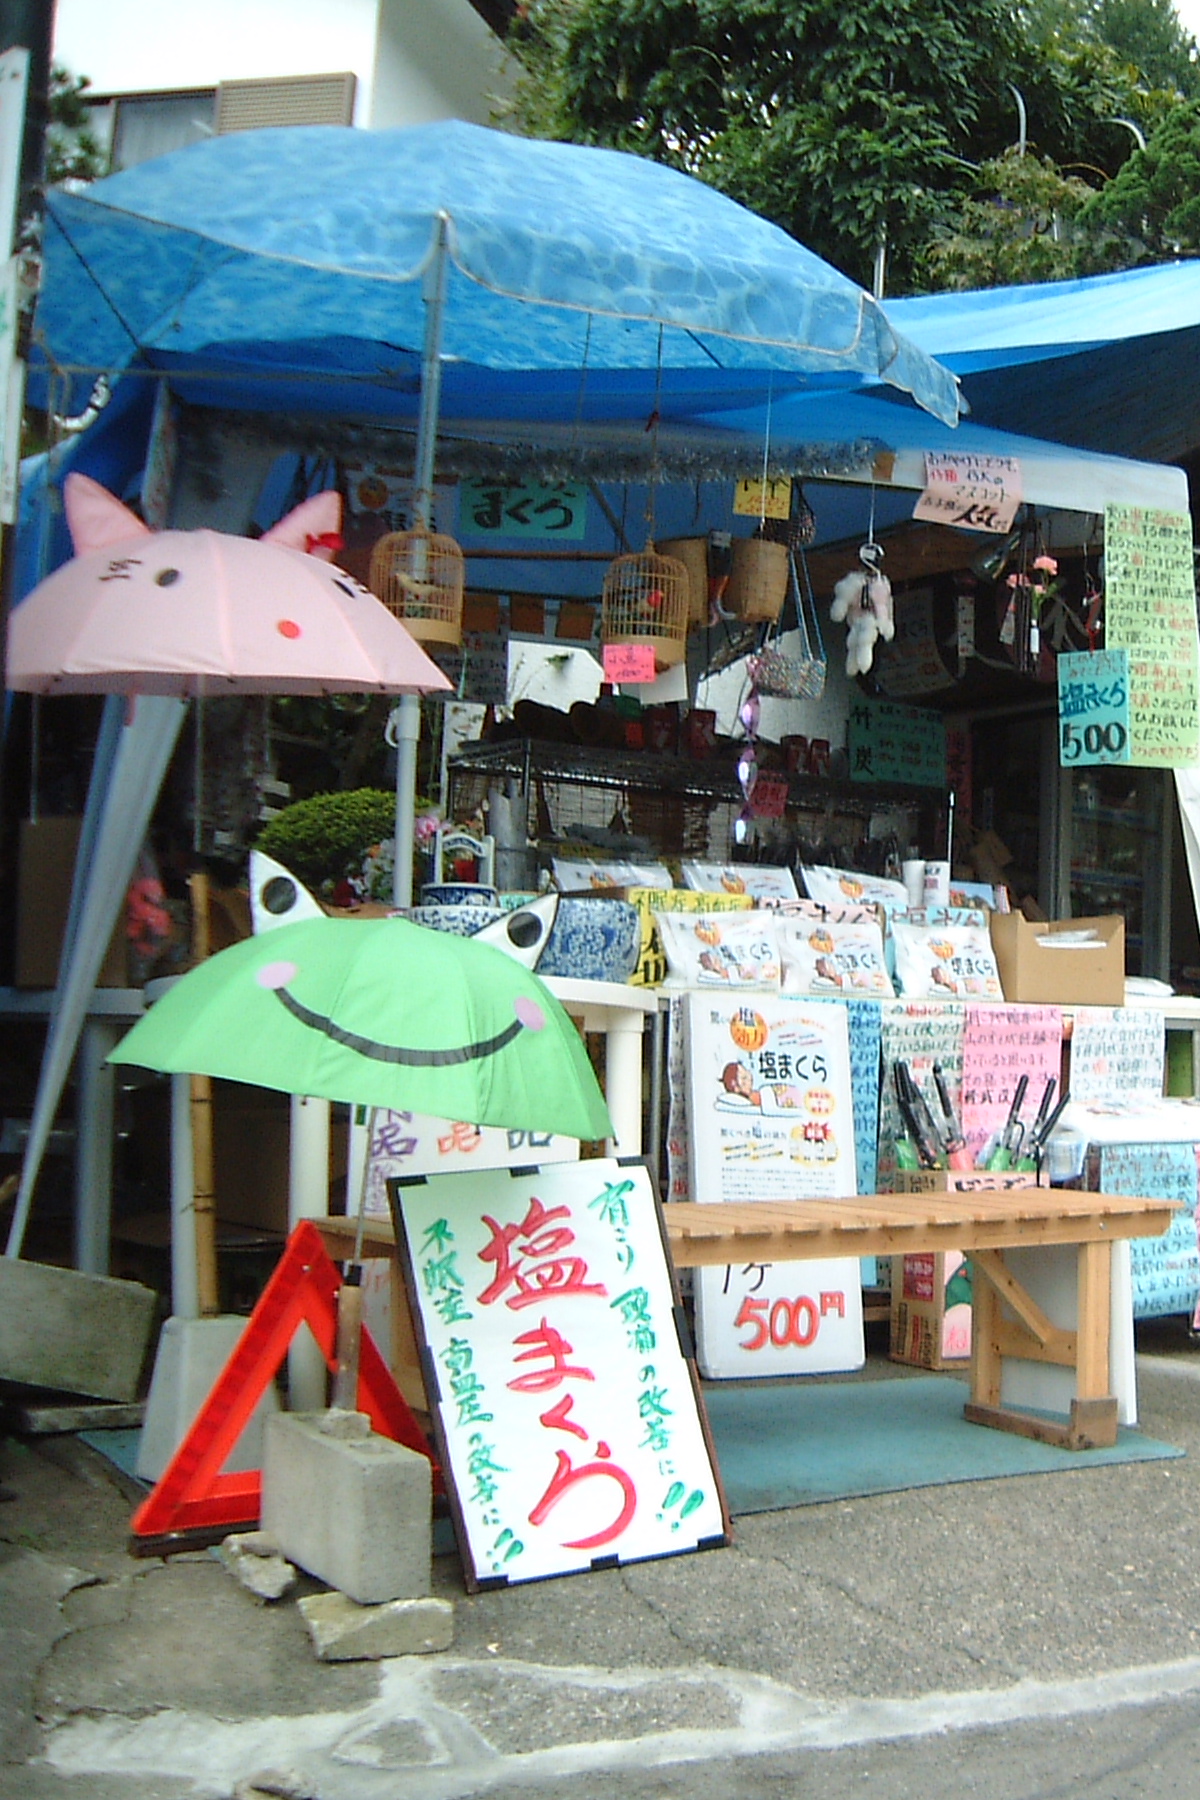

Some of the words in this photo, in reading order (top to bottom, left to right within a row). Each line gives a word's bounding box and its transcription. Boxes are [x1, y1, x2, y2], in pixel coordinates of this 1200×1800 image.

[1060, 678, 1126, 717] 塩まくら
[1061, 721, 1127, 760] 500
[951, 957, 994, 976] 塩まくら
[758, 1051, 827, 1083] 塩まくら
[734, 1290, 845, 1351] 500円
[476, 1196, 638, 1549] 塩まくら
